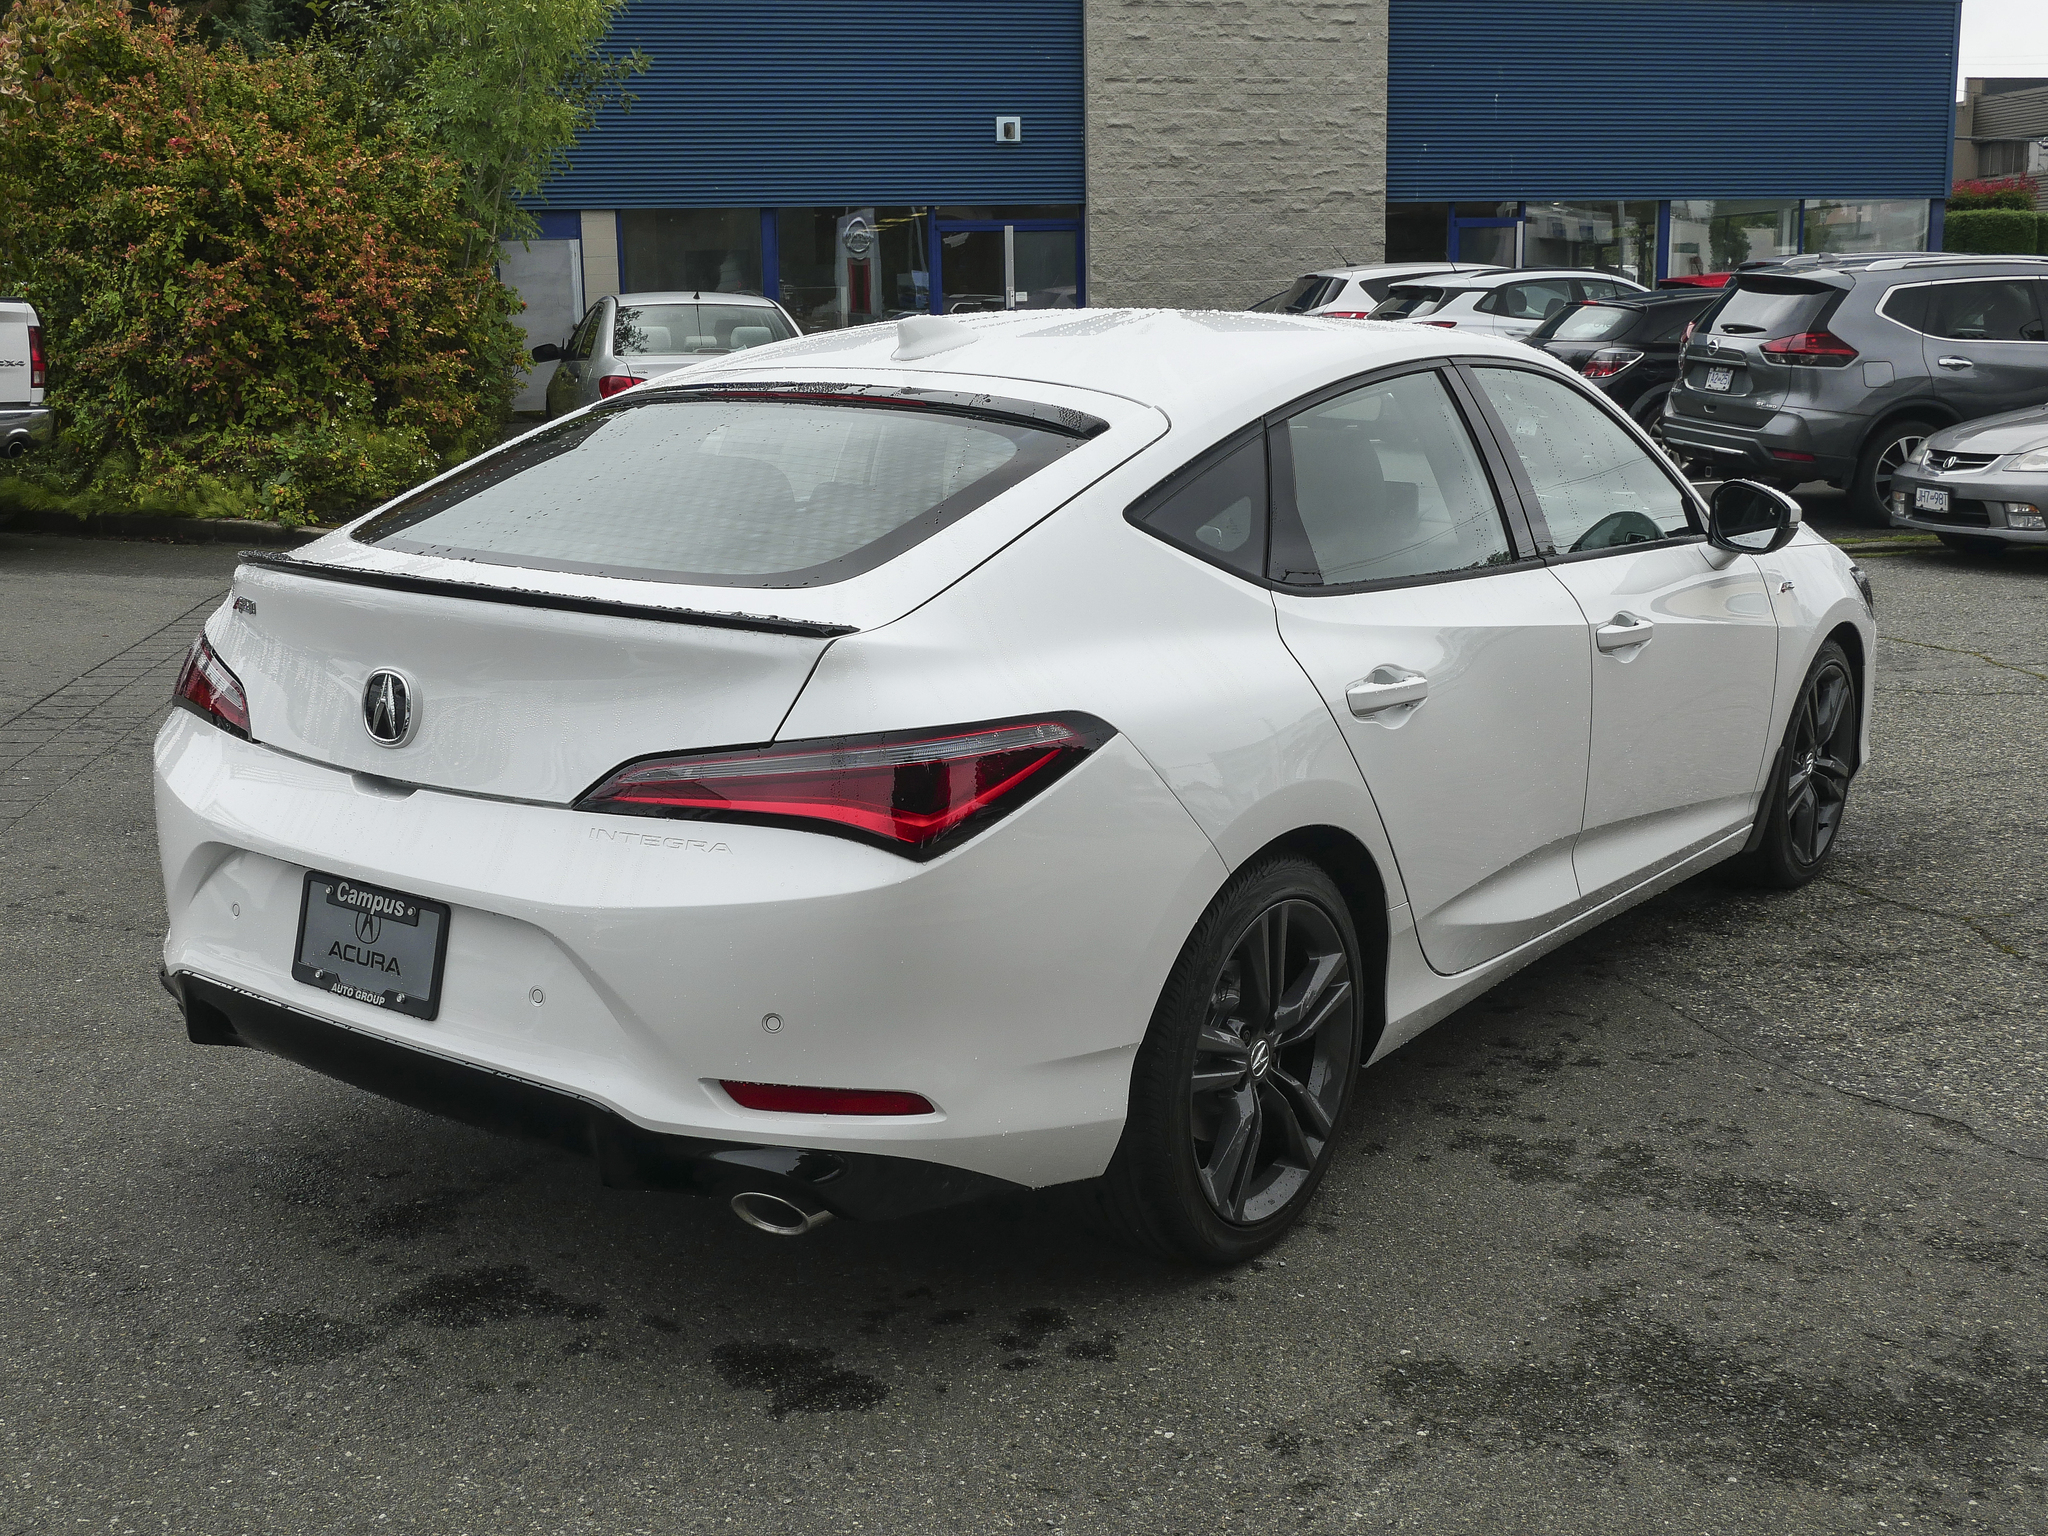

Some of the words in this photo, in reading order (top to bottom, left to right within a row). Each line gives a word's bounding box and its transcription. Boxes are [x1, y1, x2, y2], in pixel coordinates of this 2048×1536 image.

[588, 827, 734, 856] INTEGRA
[336, 881, 406, 917] Campus
[328, 940, 402, 976] ACURA
[331, 982, 354, 998] AUTO
[355, 989, 386, 1006] GROUP
